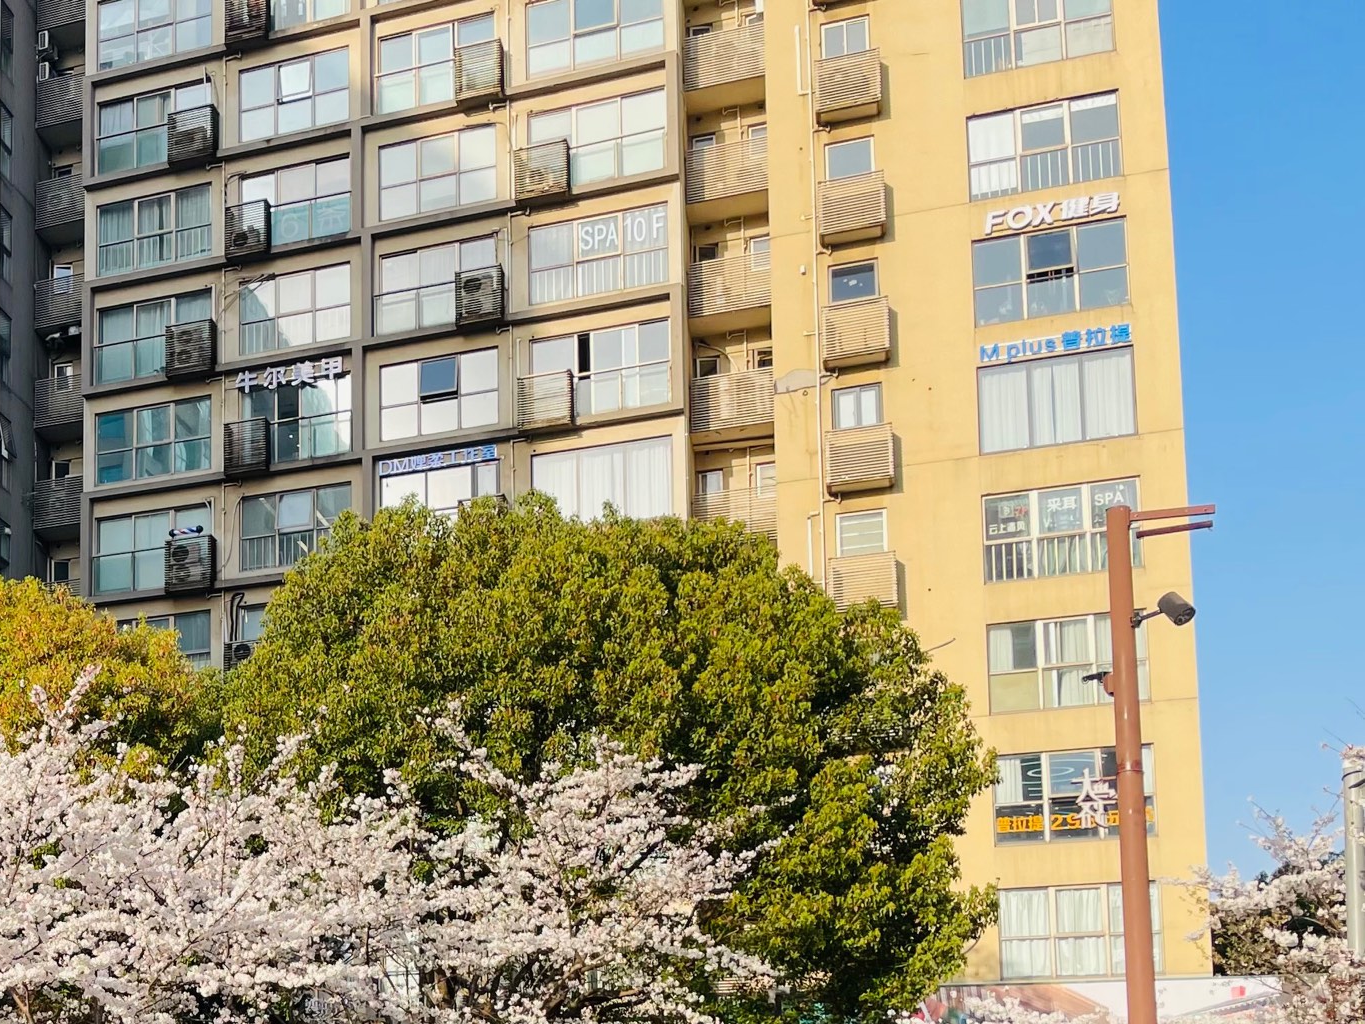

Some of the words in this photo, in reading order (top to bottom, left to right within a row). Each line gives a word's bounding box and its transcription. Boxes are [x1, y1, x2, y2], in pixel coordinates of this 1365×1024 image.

[985, 201, 1055, 234] FOX
[1061, 192, 1120, 220] 健身
[581, 222, 618, 250] SPA
[235, 356, 343, 393] 牛尔美甲
